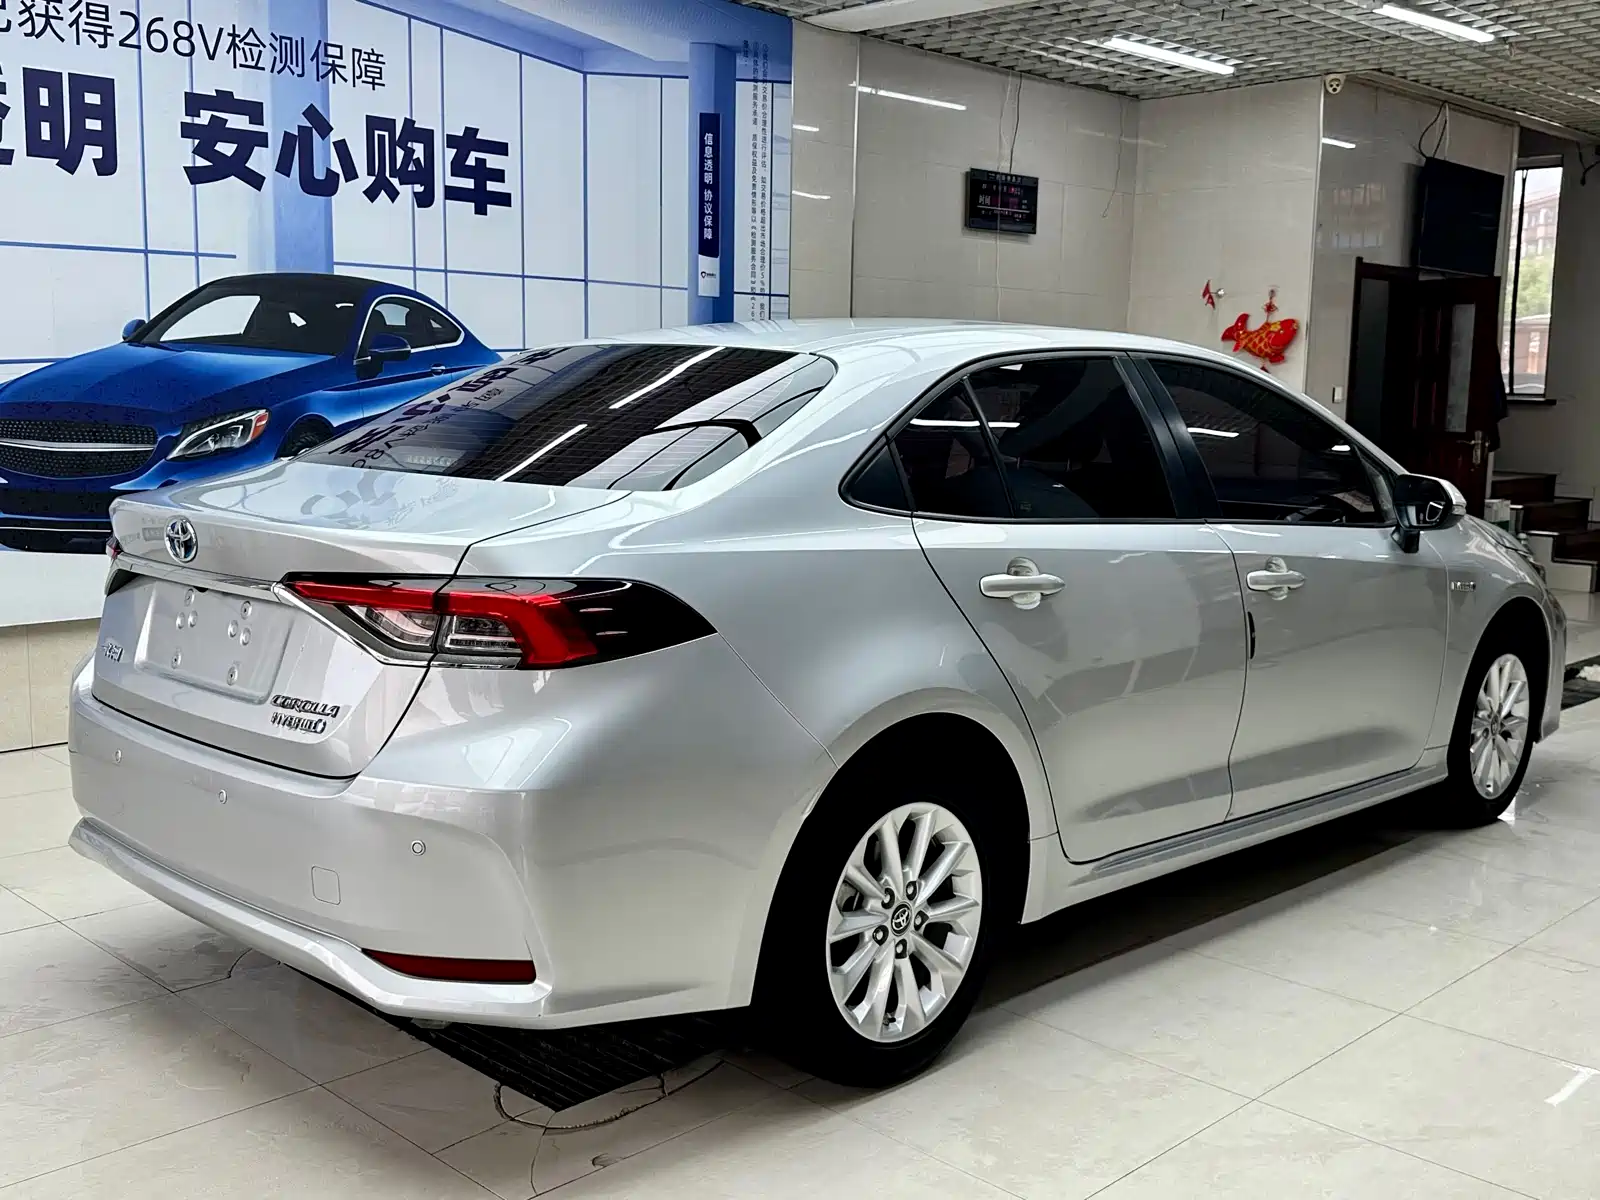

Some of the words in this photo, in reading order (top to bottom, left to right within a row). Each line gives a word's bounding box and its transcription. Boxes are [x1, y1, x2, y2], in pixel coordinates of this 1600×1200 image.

[0, 66, 118, 177] 明
[180, 89, 513, 216] 安心购车
[703, 132, 714, 185] 信息透明
[703, 188, 713, 240] 协议保障
[271, 694, 340, 718] COROLLA
